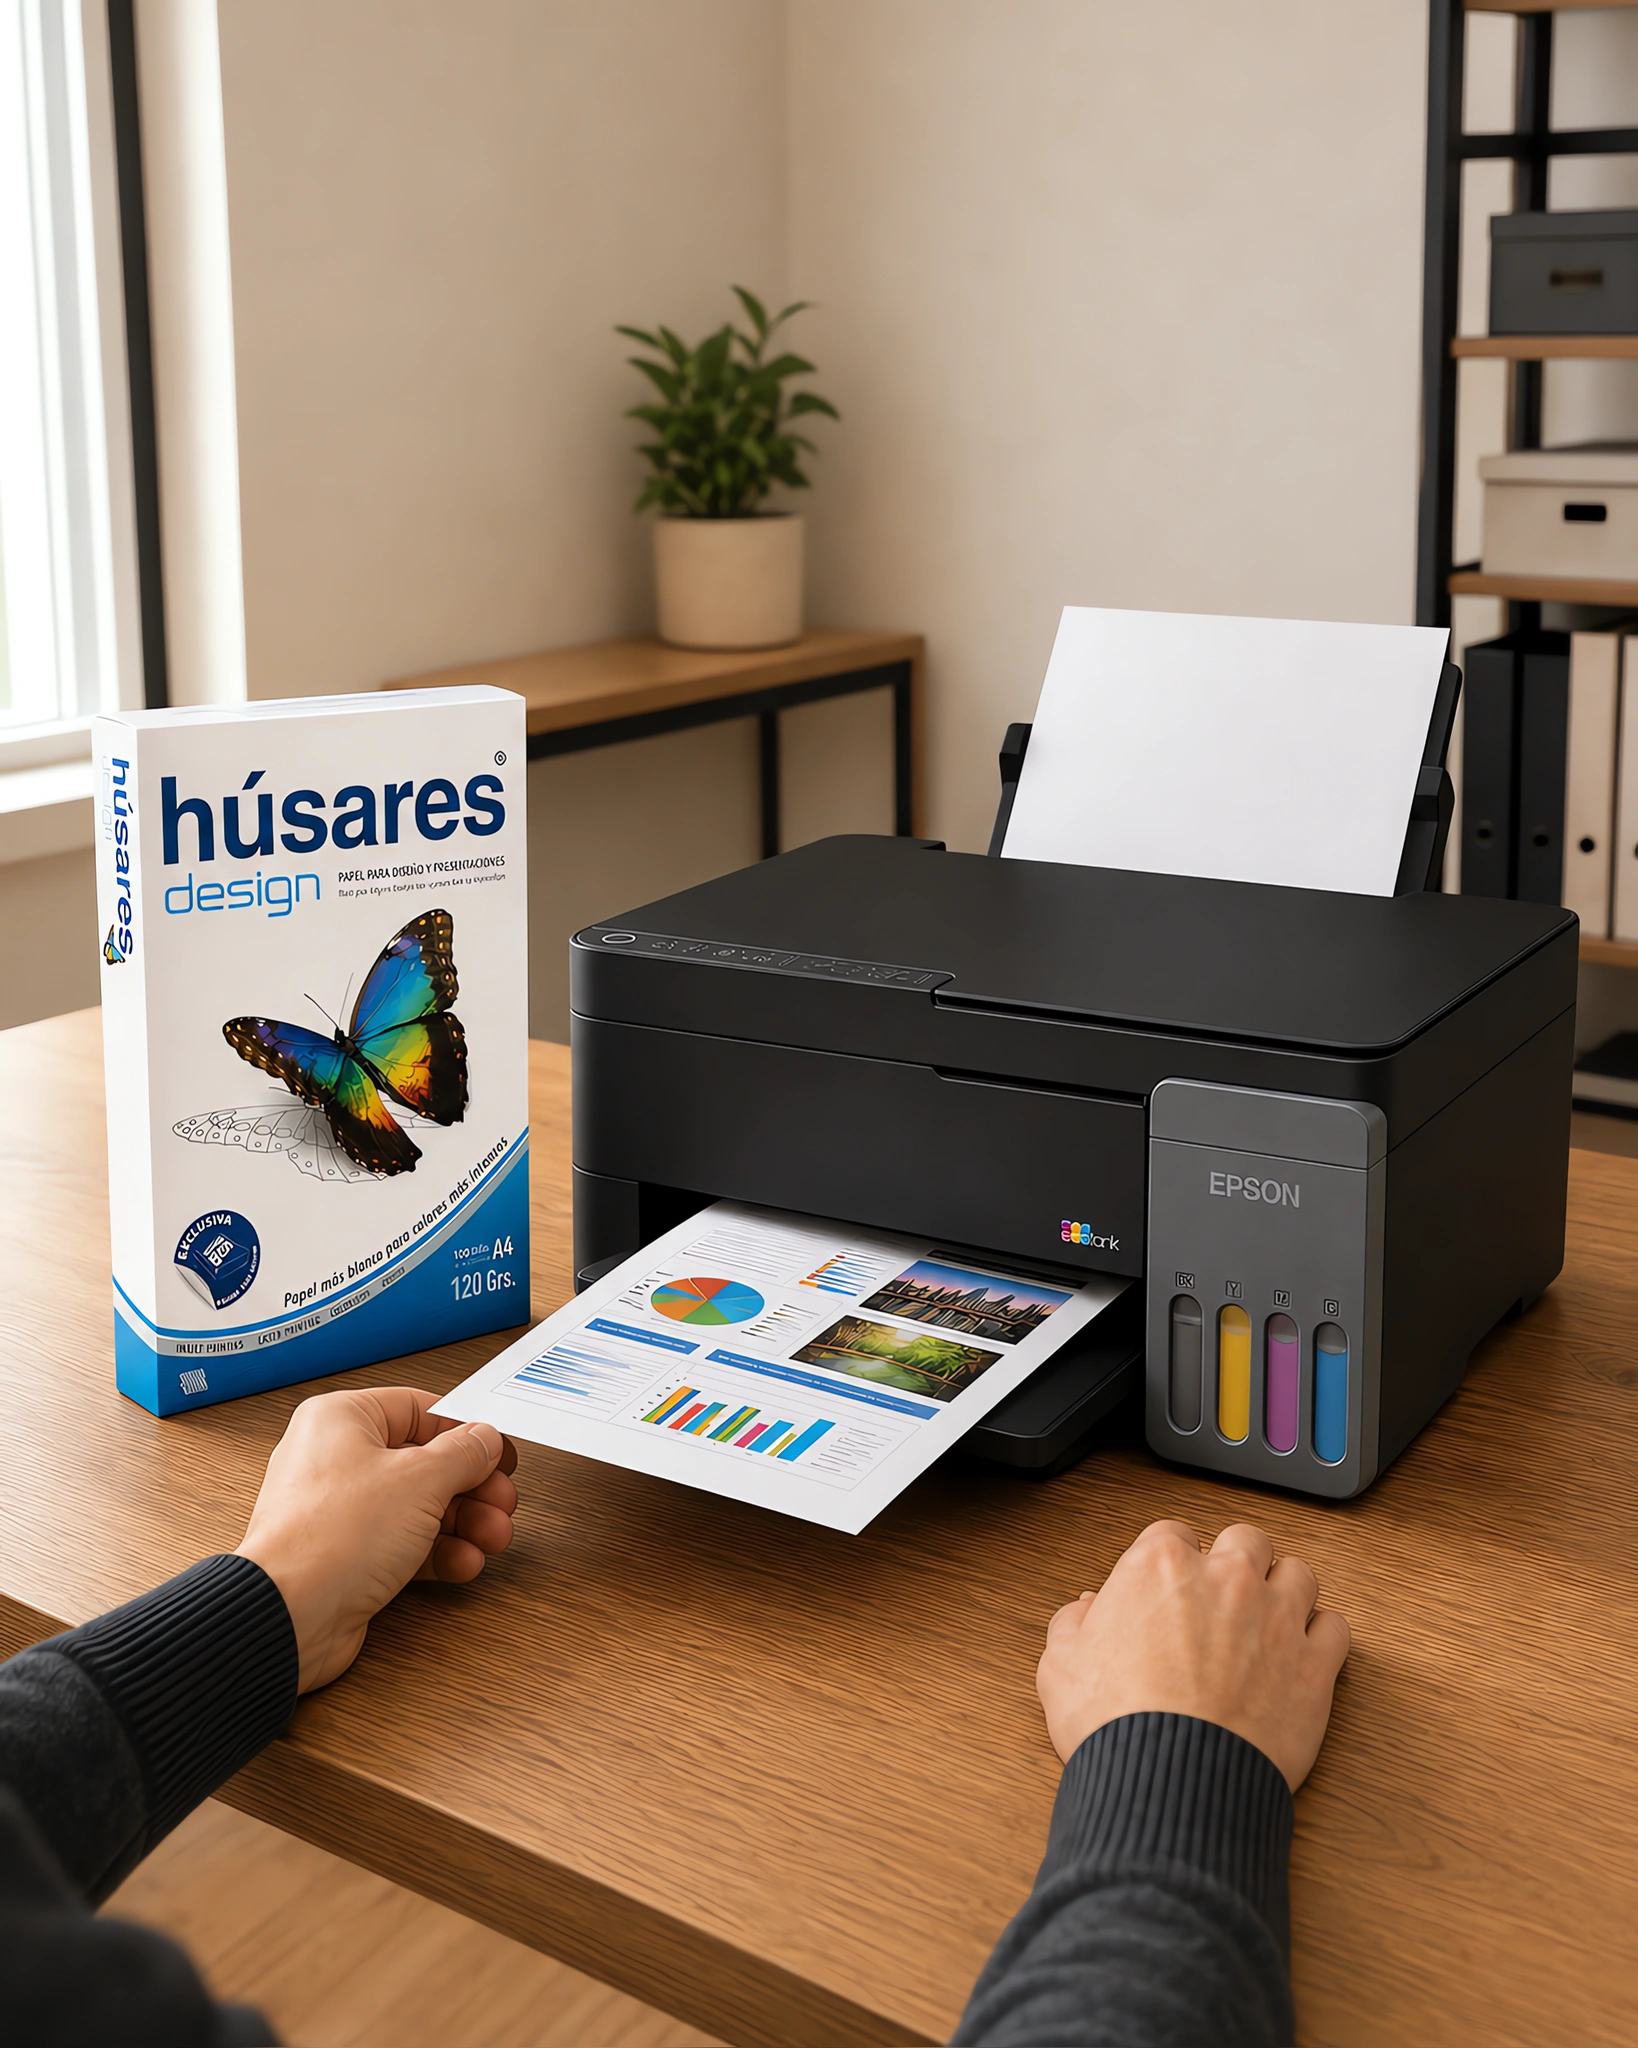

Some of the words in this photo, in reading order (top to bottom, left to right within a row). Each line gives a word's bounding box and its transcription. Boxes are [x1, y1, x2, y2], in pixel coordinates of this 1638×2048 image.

[161, 770, 506, 865] húsares
[112, 757, 134, 955] húsares
[164, 871, 321, 918] design
[1209, 1171, 1300, 1209] EPSON
[348, 1251, 384, 1279] blanco
[492, 1235, 514, 1260] A4
[450, 1271, 482, 1301] 120
[486, 1269, 516, 1292] Grs.
